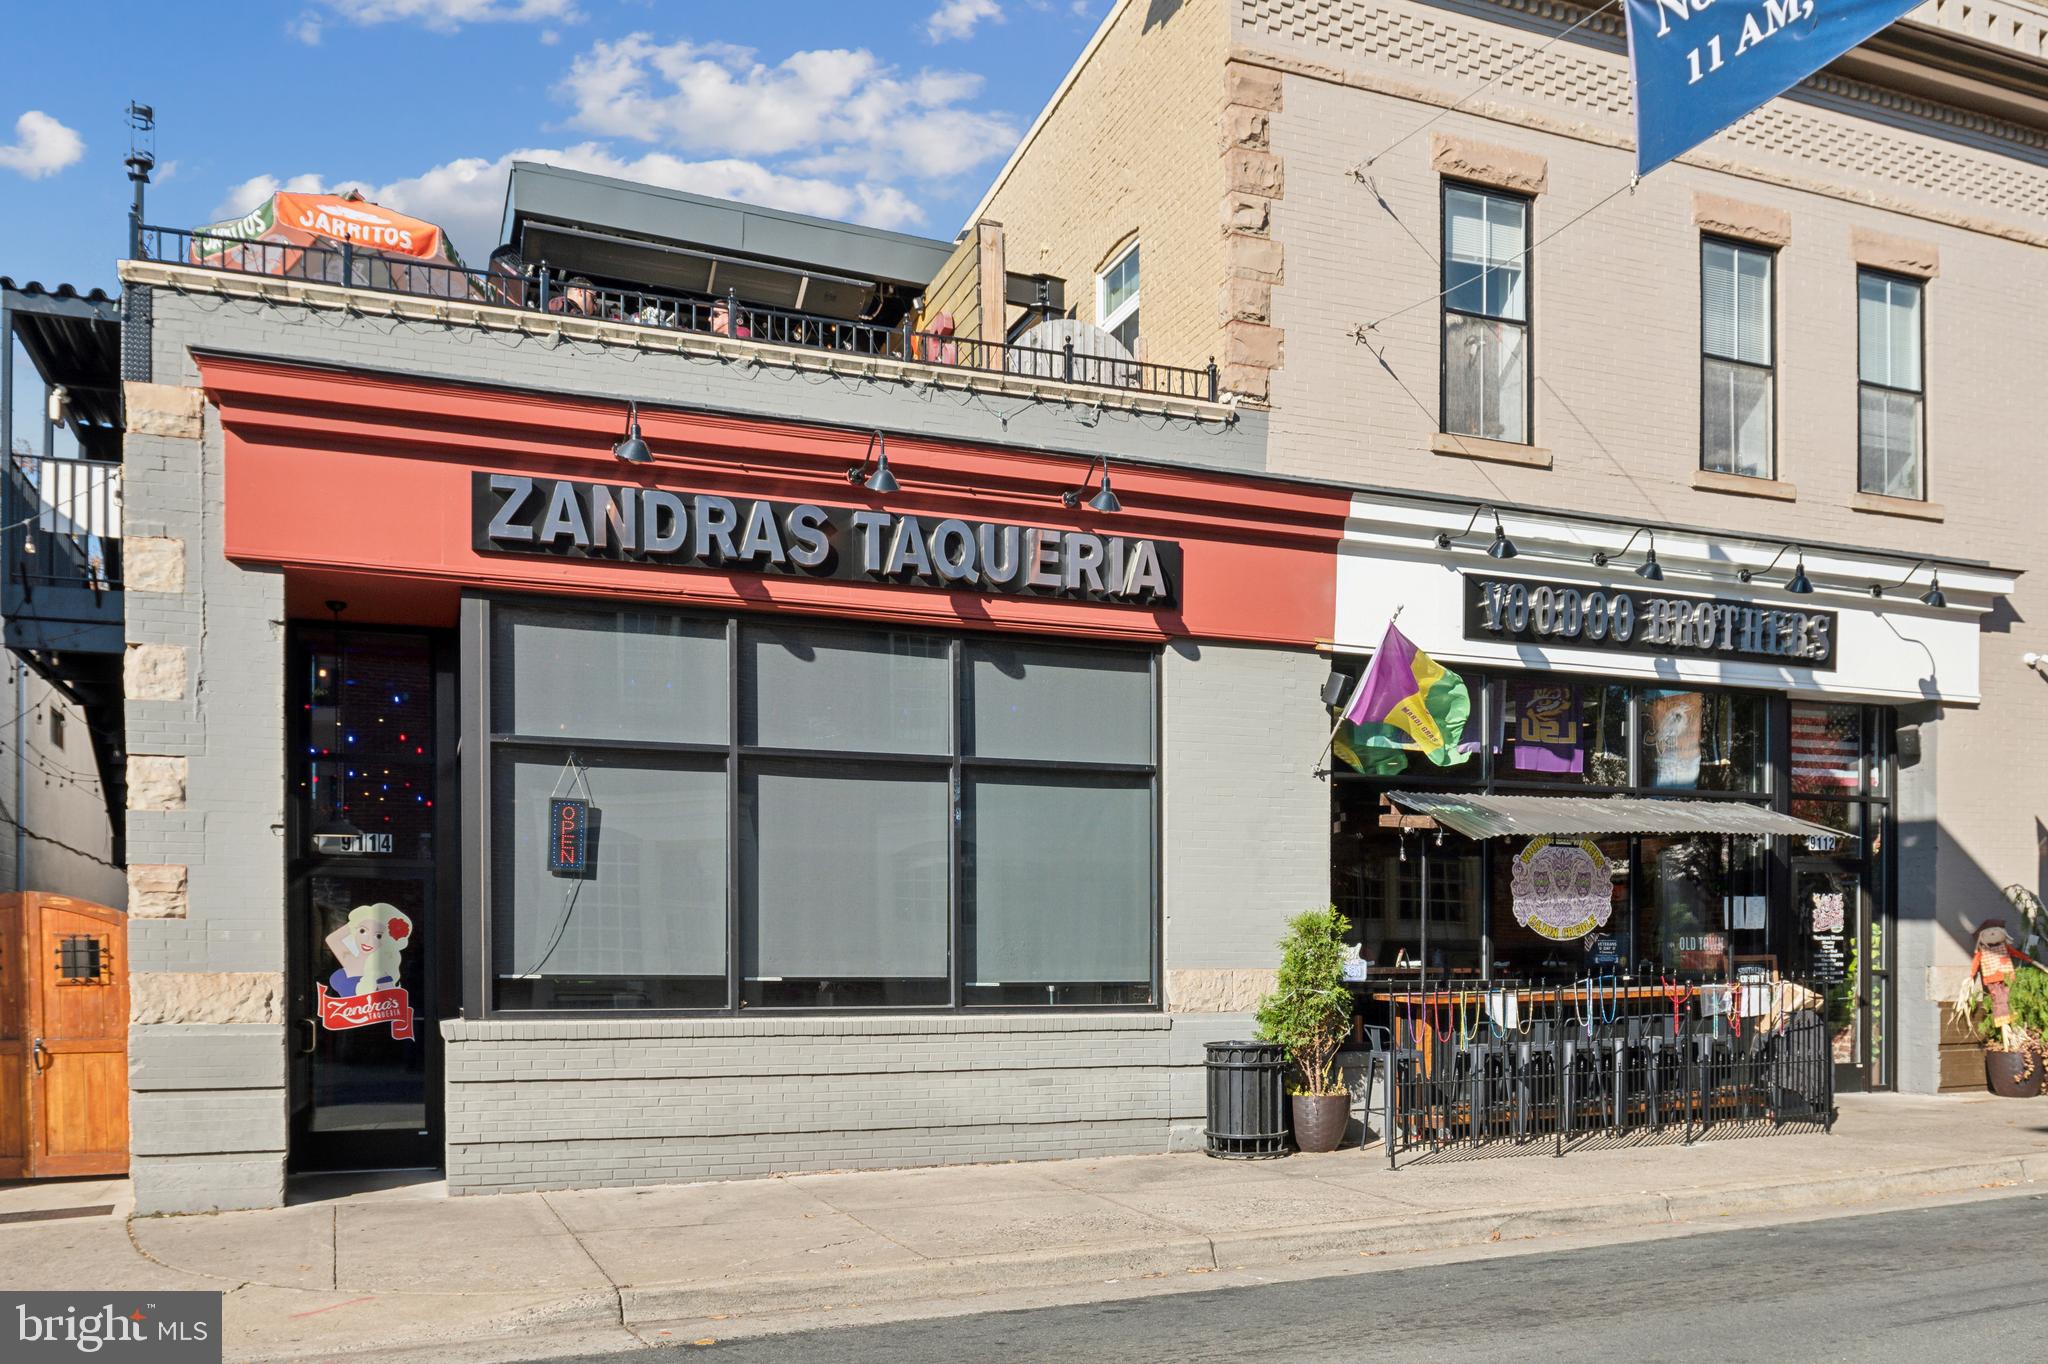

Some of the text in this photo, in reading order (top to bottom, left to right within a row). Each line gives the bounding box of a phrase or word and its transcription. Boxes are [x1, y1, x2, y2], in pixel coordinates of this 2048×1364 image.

[1686, 0, 1815, 85] 11 AM,
[299, 210, 413, 250] JARRITOS
[488, 474, 1168, 598] ZANDRAS TAQUERIA
[1479, 580, 1831, 662] VOODOO BROTHERS
[1401, 706, 1439, 743] MARDI GRAS
[341, 834, 391, 852] 9114
[560, 805, 576, 864] OPEN
[1810, 836, 1835, 850] 9112
[1528, 913, 1597, 939] CAJUN CREOLE
[1679, 936, 1696, 950] OLD
[327, 994, 400, 1024] Zandra's
[368, 1009, 401, 1021] TAQUERIA
